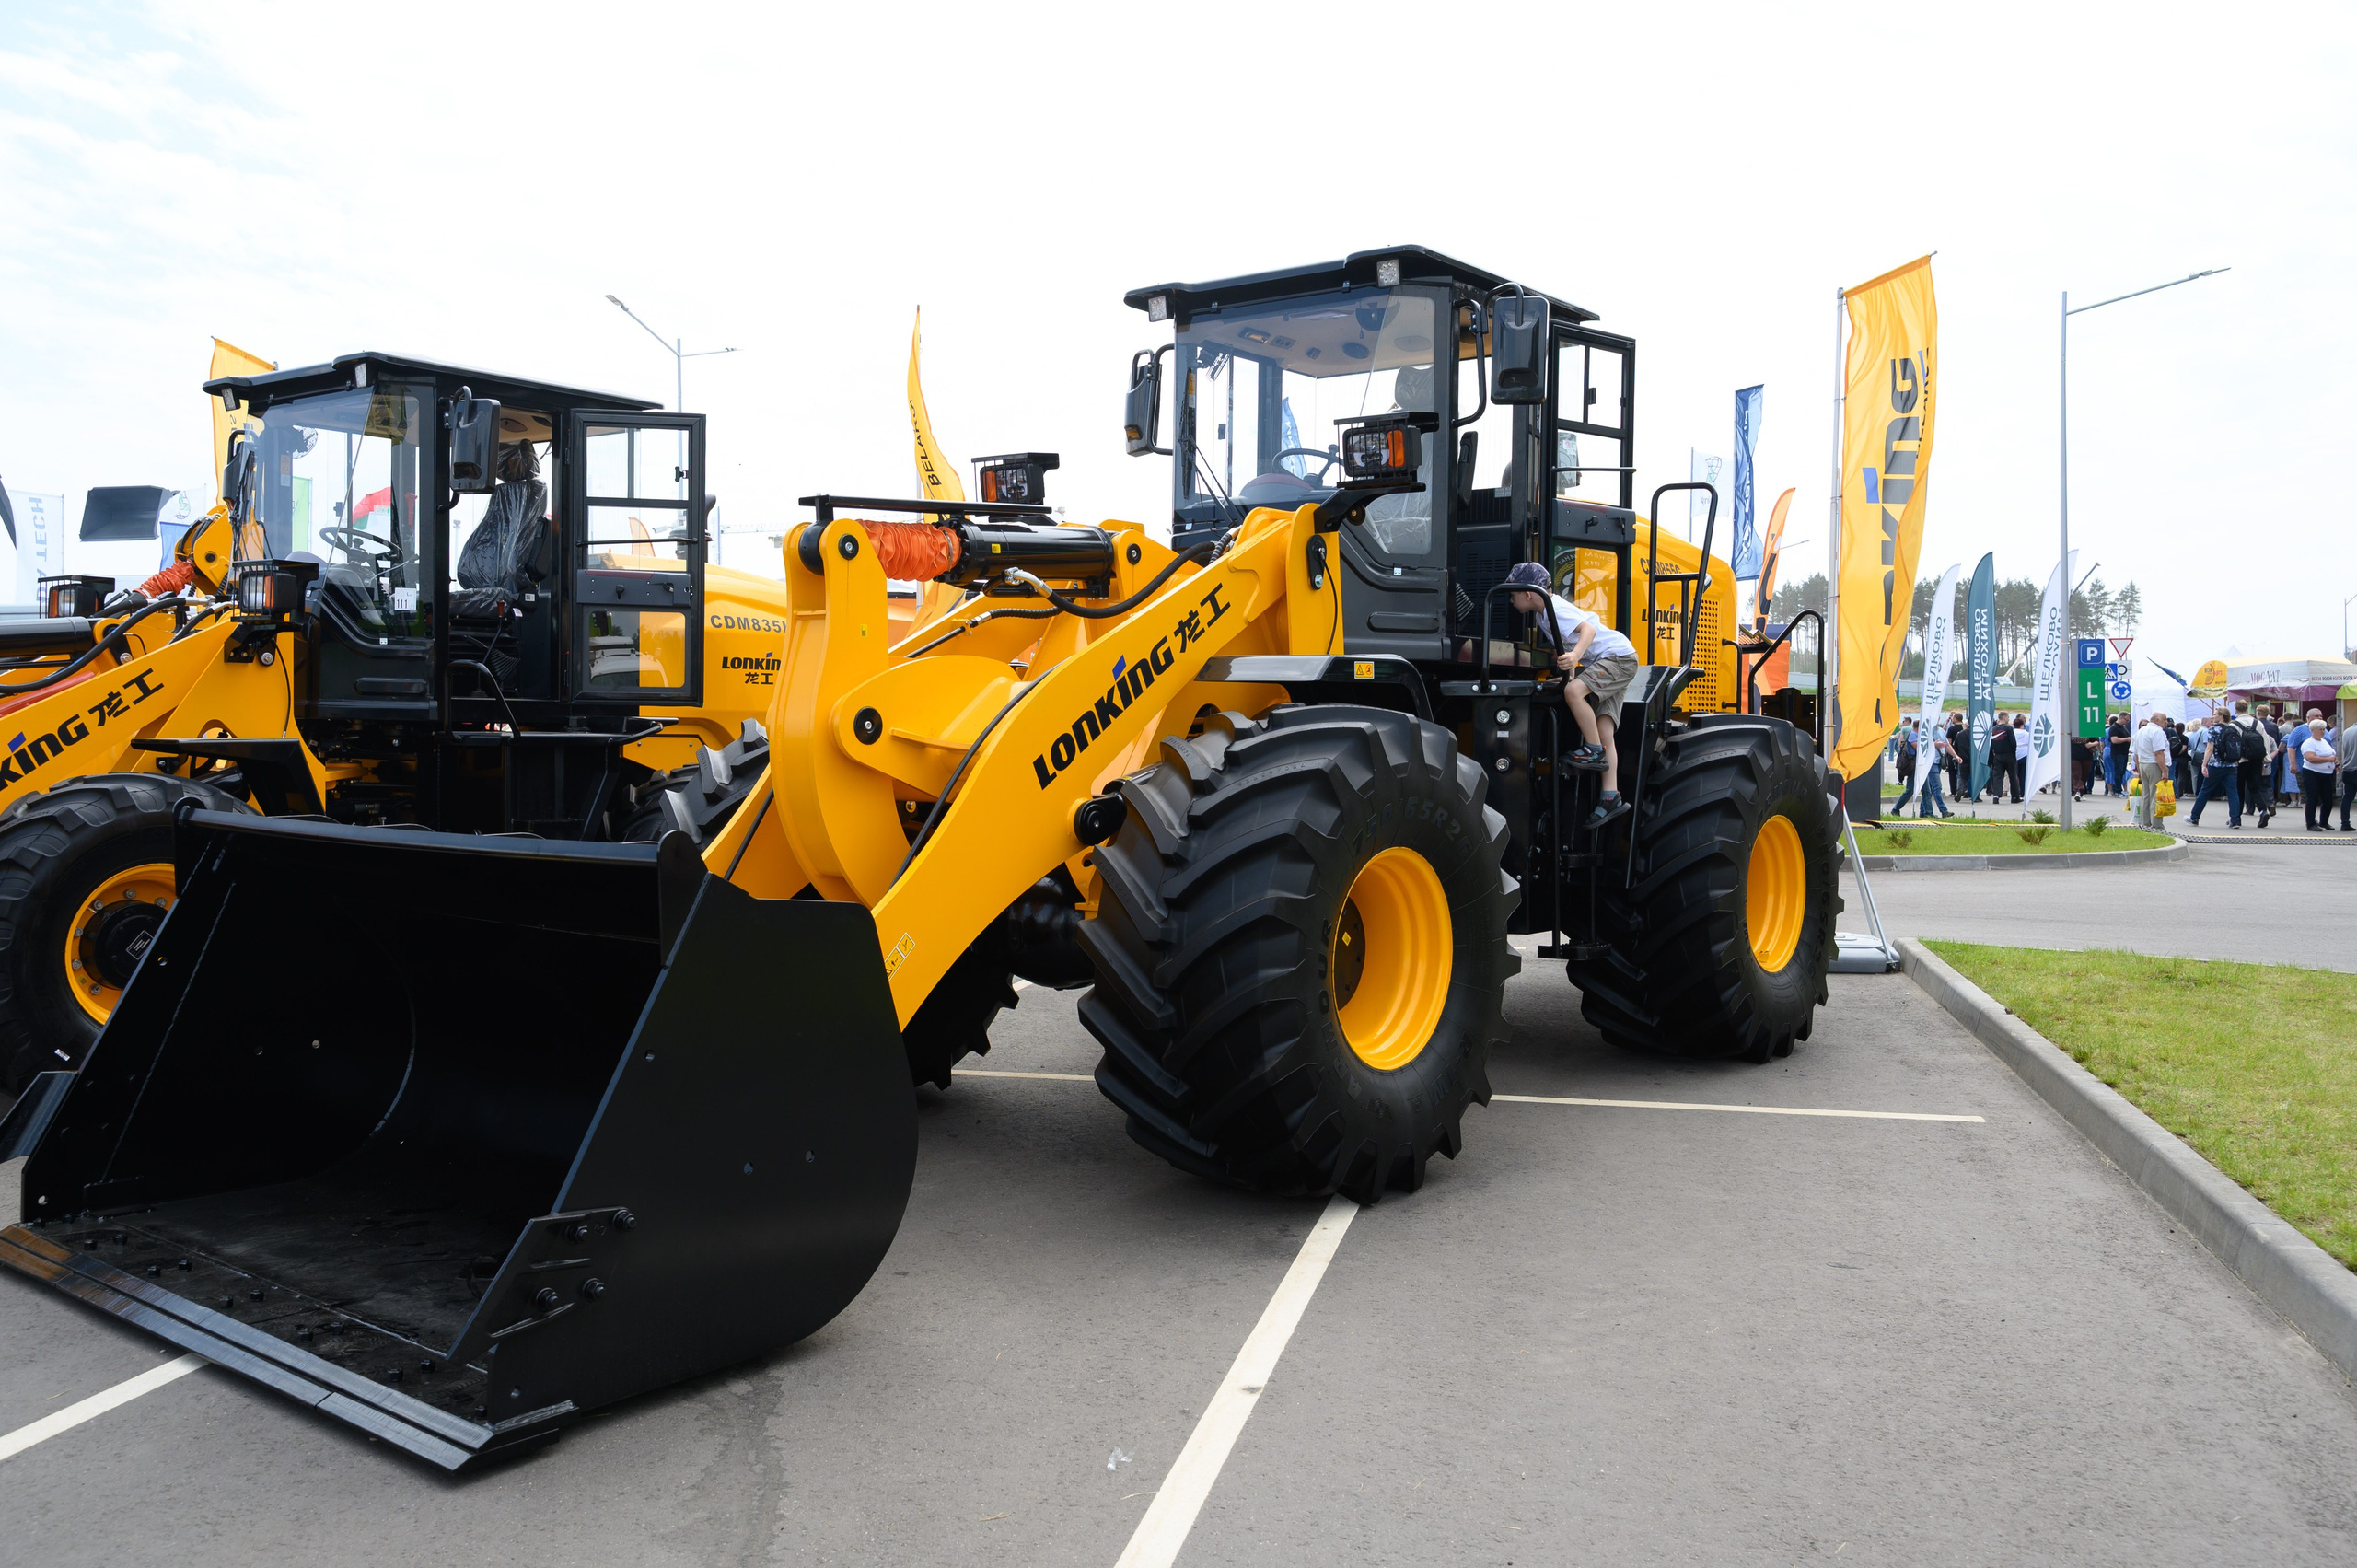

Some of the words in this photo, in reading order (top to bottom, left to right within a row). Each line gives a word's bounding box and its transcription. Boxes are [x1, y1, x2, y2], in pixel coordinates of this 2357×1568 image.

[397, 598, 408, 609] 111
[1641, 603, 1683, 624] LNKIN
[1925, 616, 1943, 705] ЩЕЛКОВО
[1973, 608, 1982, 700] ЩЕЛКОВО
[1980, 608, 1991, 701] АГРОХИМ
[2039, 606, 2058, 701] ЩЕЛКОВО
[2086, 646, 2098, 661] P
[87, 668, 165, 727] 龙工
[744, 671, 774, 685] 龙工
[1032, 635, 1175, 790] LONKING
[1173, 582, 1231, 654] 龙工
[2086, 681, 2098, 699] L
[2084, 706, 2099, 723] 11
